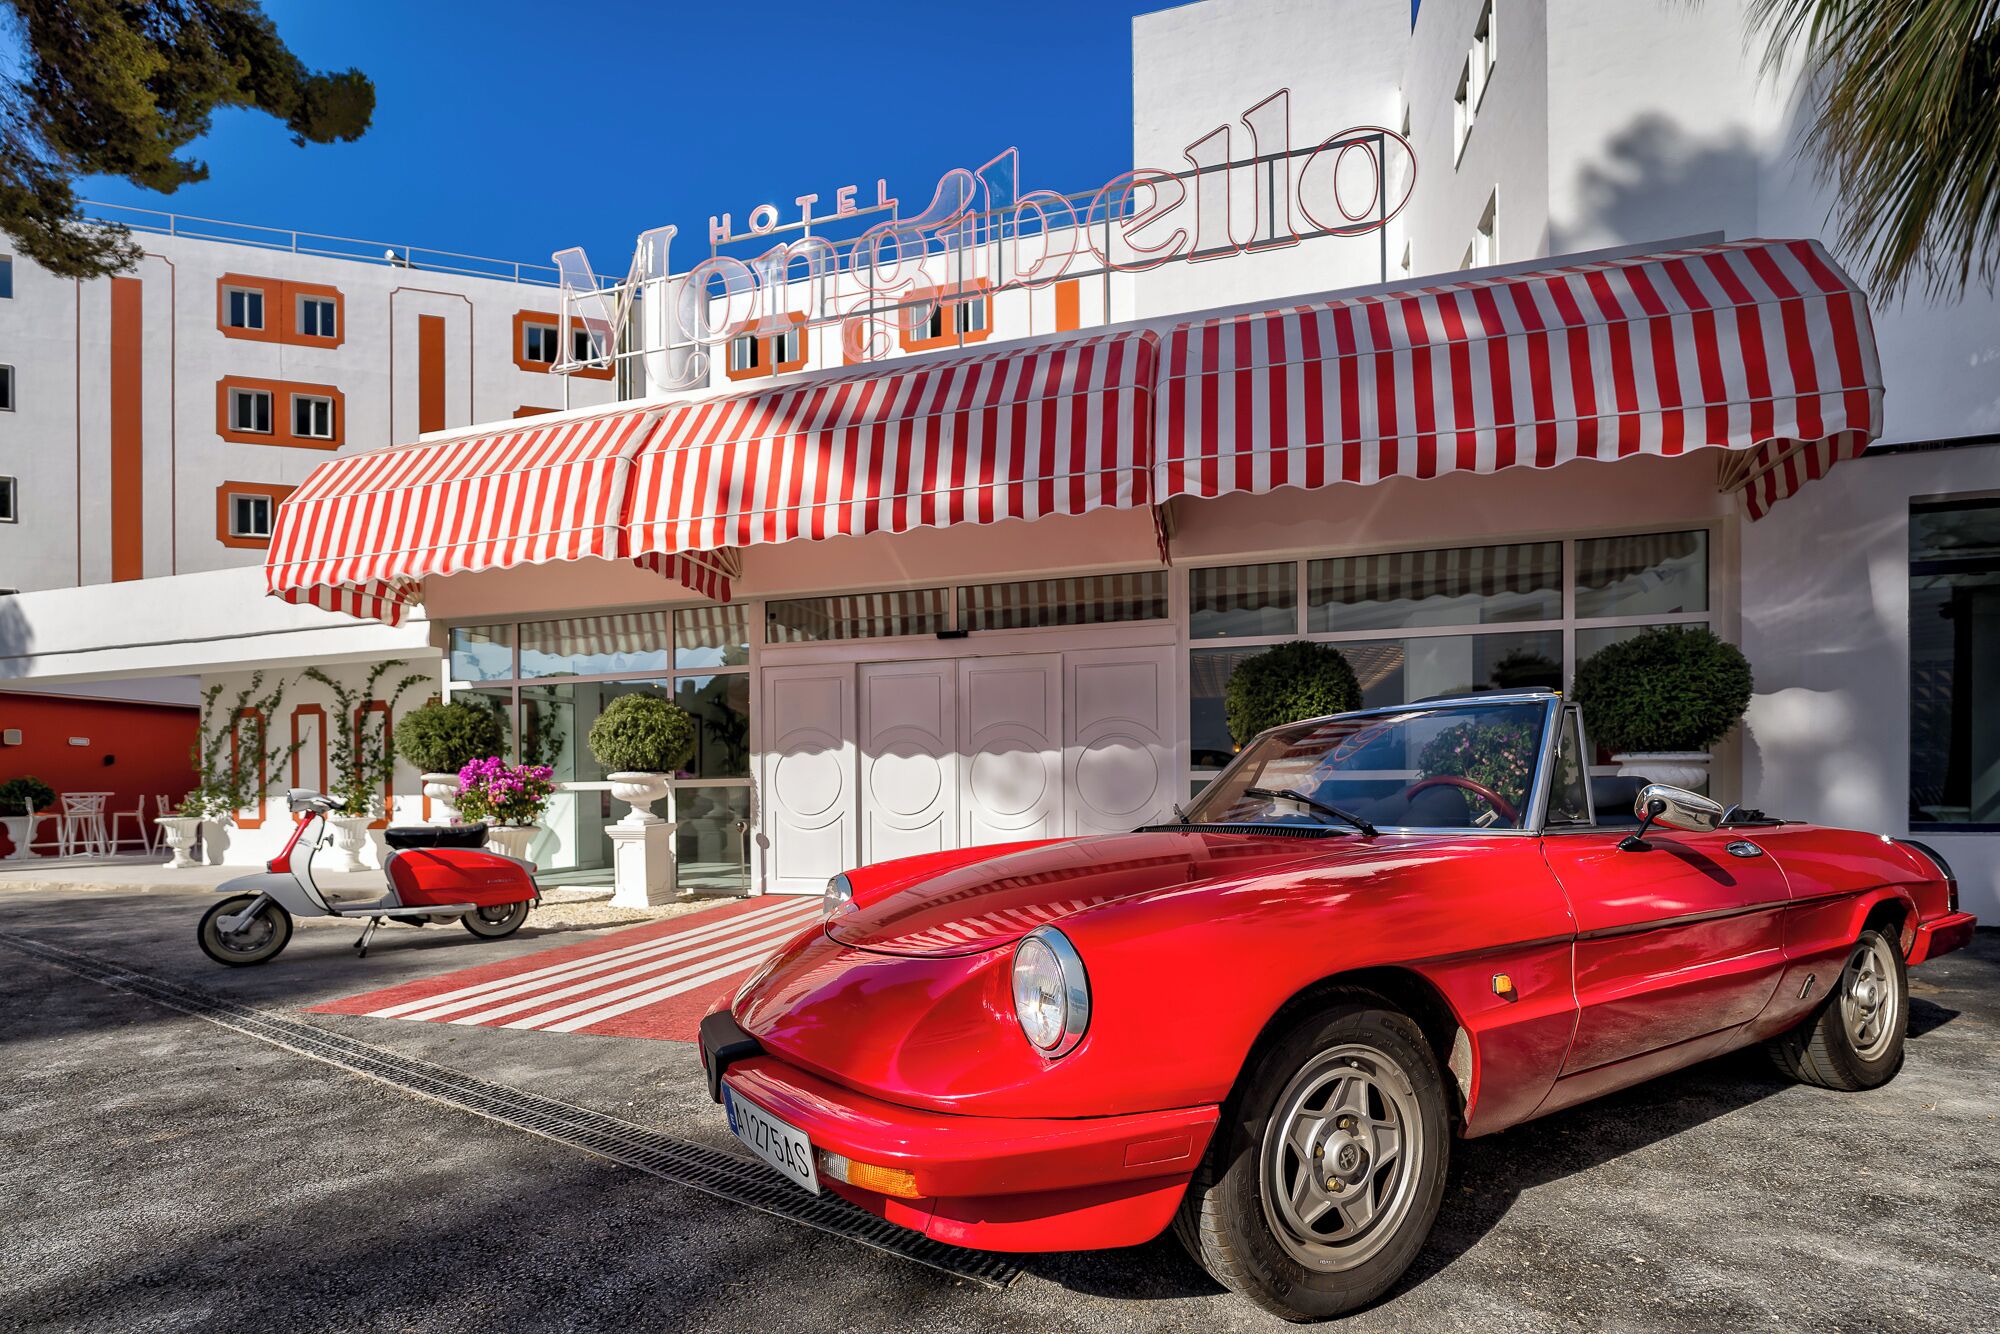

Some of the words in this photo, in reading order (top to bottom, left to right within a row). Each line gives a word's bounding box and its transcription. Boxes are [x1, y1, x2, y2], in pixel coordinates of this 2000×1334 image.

[549, 87, 1417, 391] Mongibello
[709, 178, 899, 245] HOTEL
[734, 1102, 810, 1178] A1275AS
